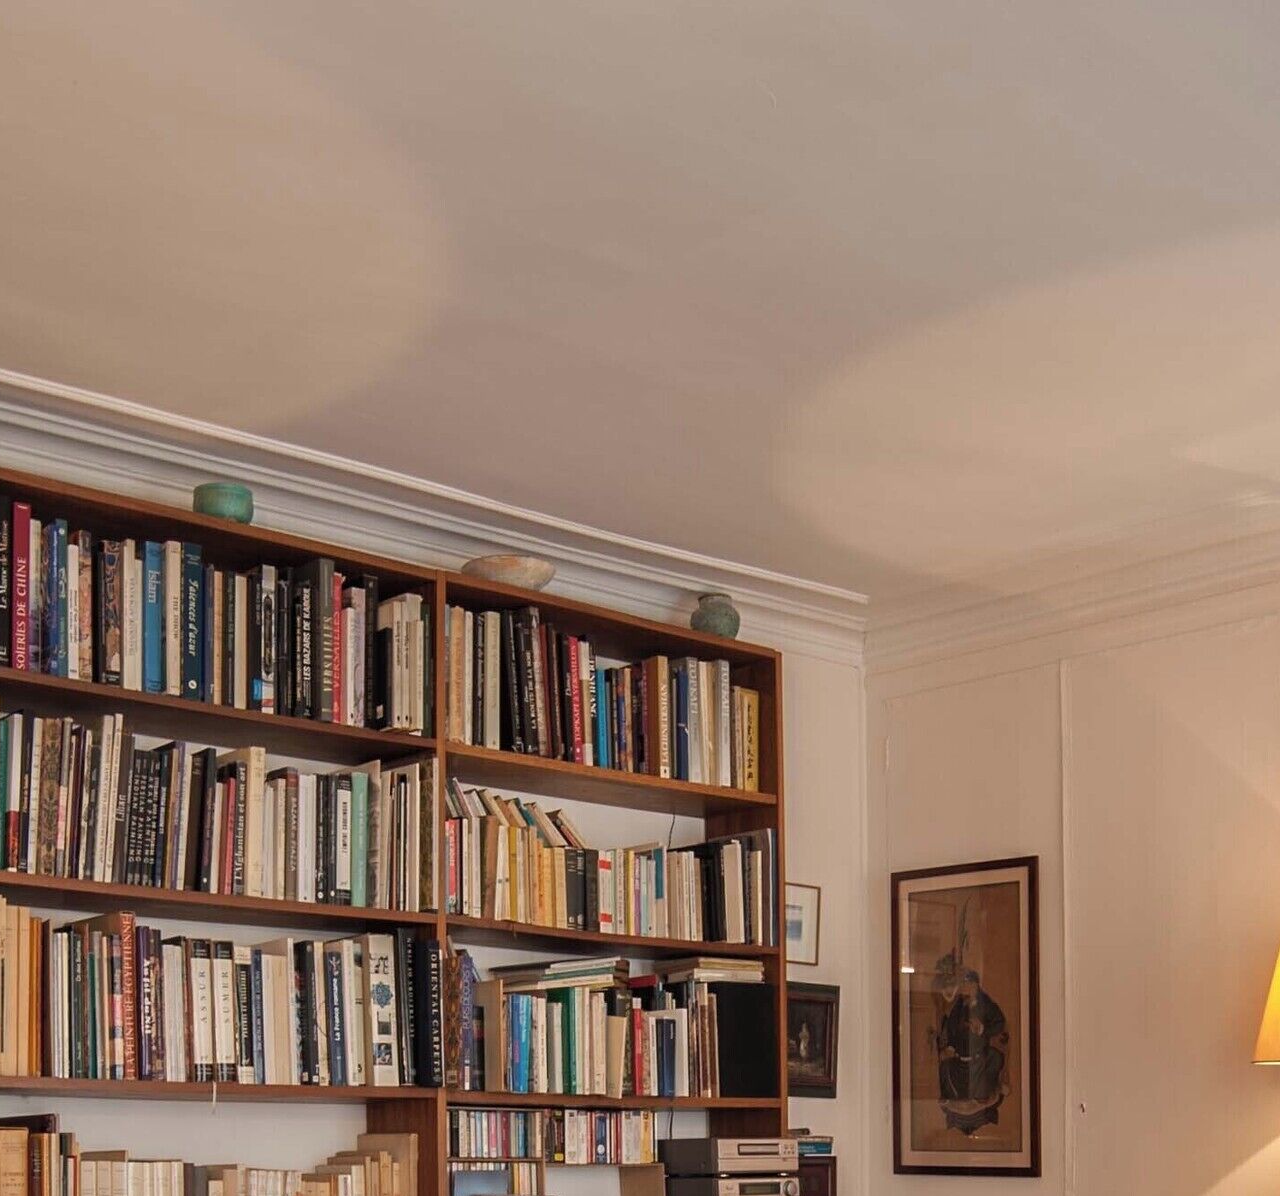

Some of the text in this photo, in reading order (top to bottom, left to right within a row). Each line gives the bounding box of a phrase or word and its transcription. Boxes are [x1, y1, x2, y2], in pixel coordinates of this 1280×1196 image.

[15, 556, 26, 669] SOIERIES DE CHINE
[148, 569, 160, 604] Islam
[303, 620, 311, 632] DE
[303, 632, 311, 665] BAZARS
[303, 666, 311, 681] LES
[322, 616, 333, 693] VERSAILLES
[128, 775, 140, 863] INDIAN PAINTING
[135, 775, 147, 862] PERSIAN PAINTING
[237, 803, 245, 813] et
[234, 815, 245, 881] L'Afghanistan
[199, 970, 208, 1024] ASSUR
[222, 971, 231, 1023] SUMER
[430, 954, 440, 1073] ORIENTAL CARPETS
[124, 997, 135, 1055] PEINTURE
[334, 1032, 341, 1041] La
[125, 1057, 135, 1073] LA
